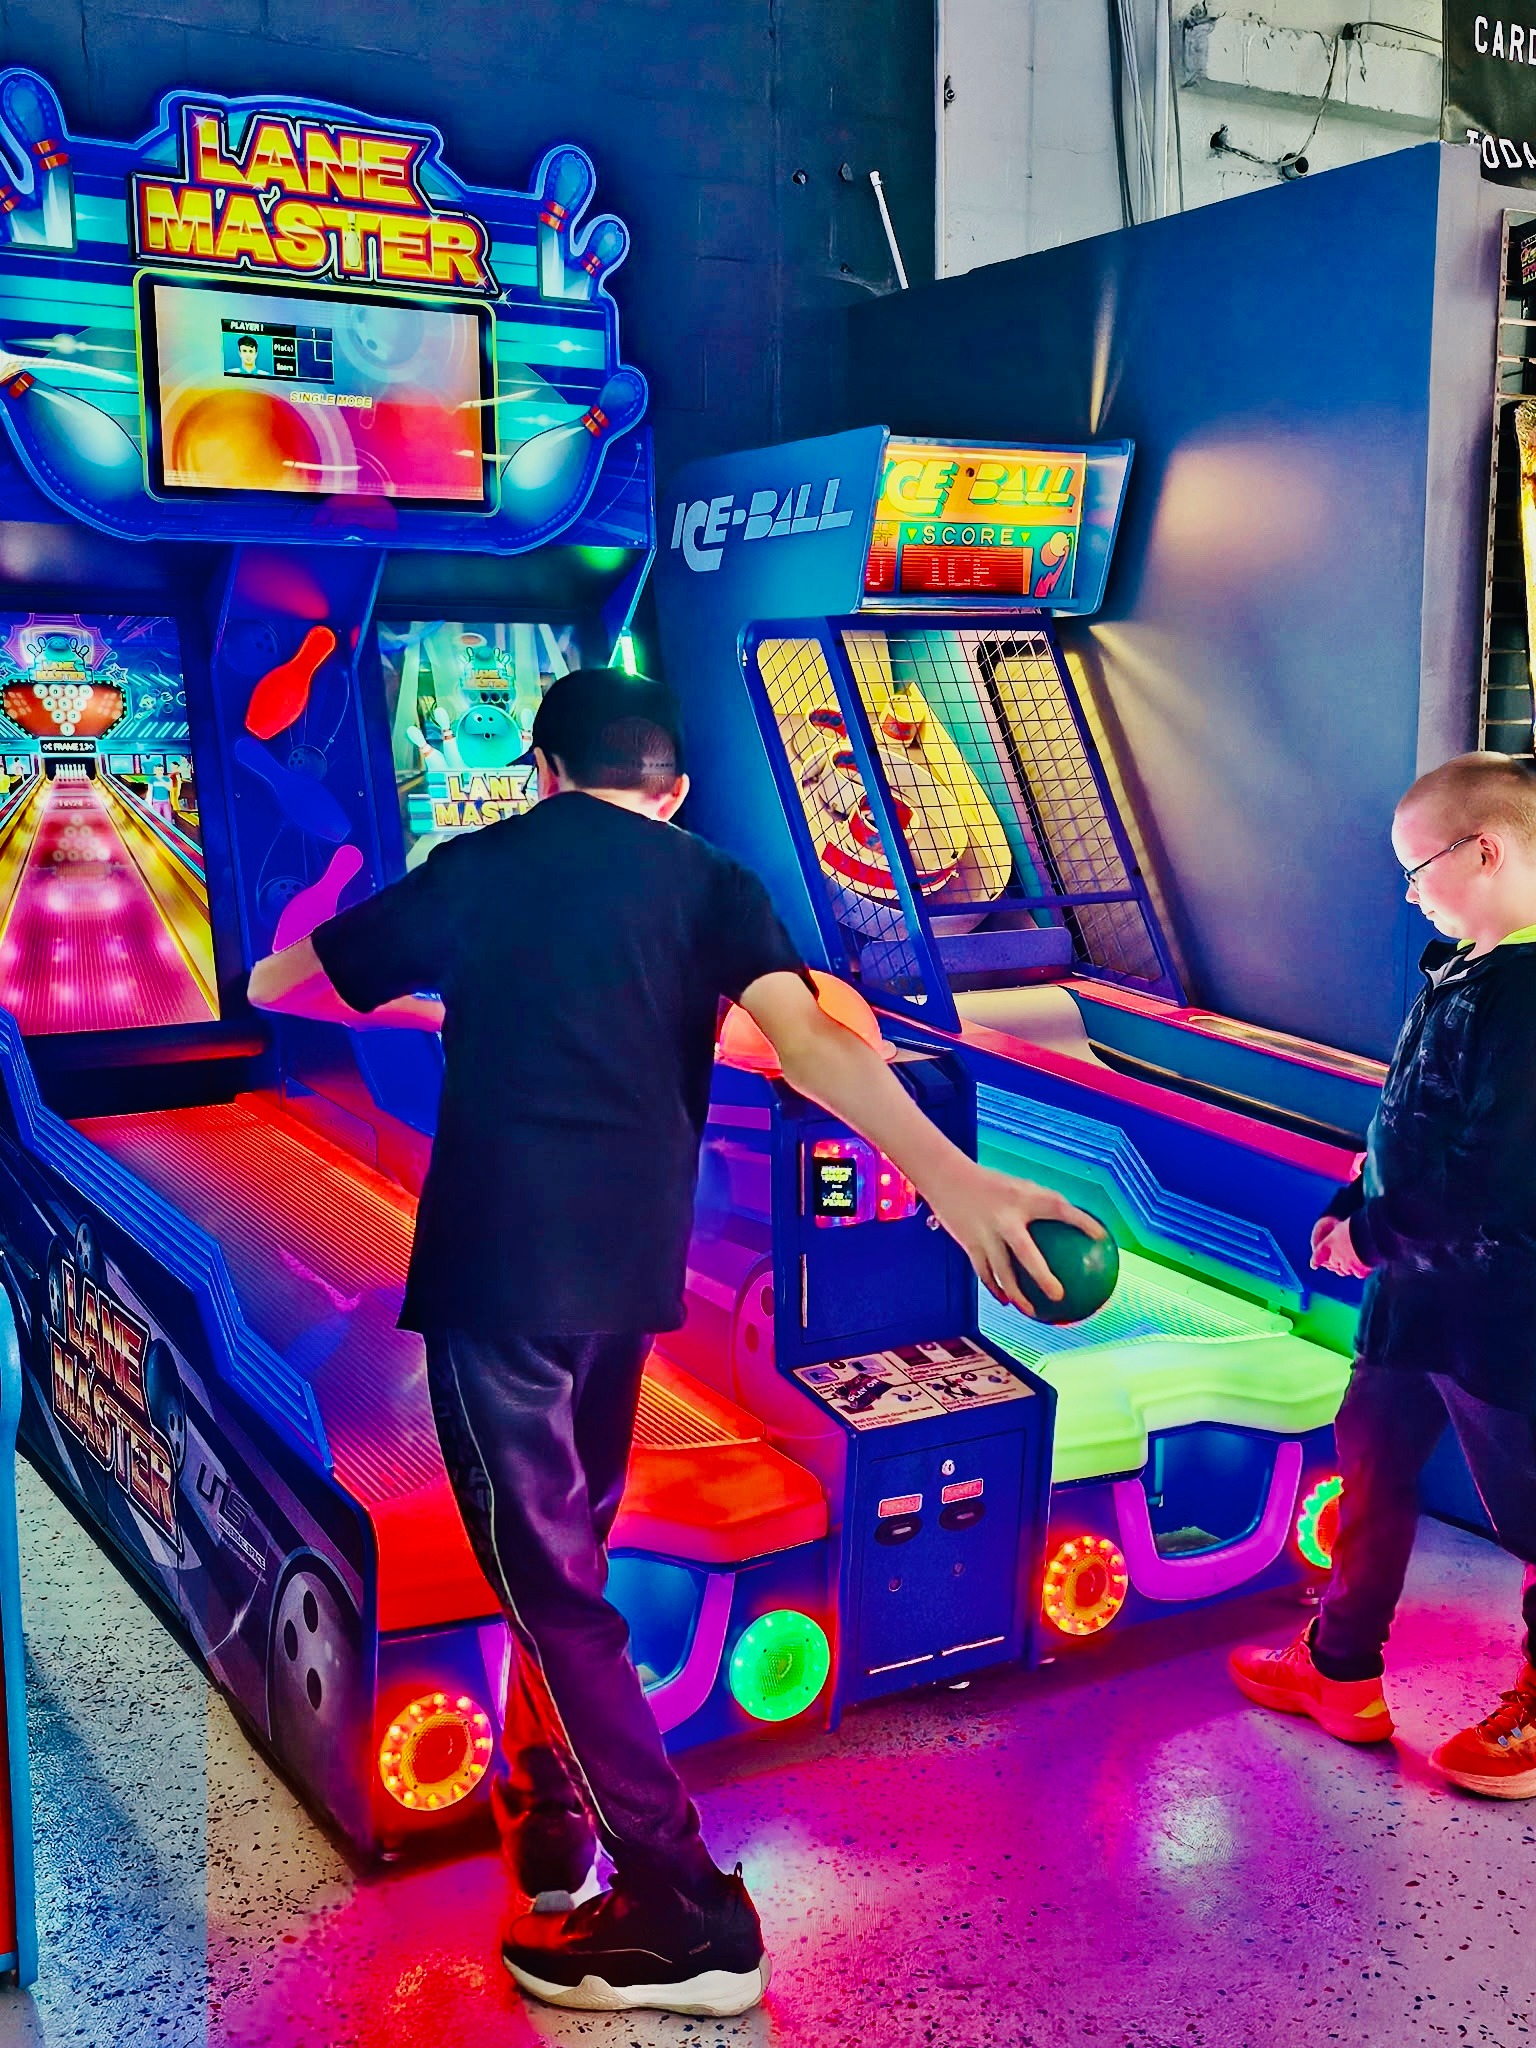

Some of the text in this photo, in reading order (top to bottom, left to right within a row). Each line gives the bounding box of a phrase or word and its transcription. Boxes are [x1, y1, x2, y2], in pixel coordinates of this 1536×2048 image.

[197, 116, 418, 207] LANE
[144, 186, 486, 285] MASTER
[311, 328, 316, 338] 1
[290, 391, 373, 408] SINGLE MODE
[968, 462, 1076, 508] BALL
[921, 524, 1016, 546] SCORE
[436, 801, 532, 827] MAST
[65, 1268, 145, 1412] LANE
[53, 1340, 177, 1537] MASTER
